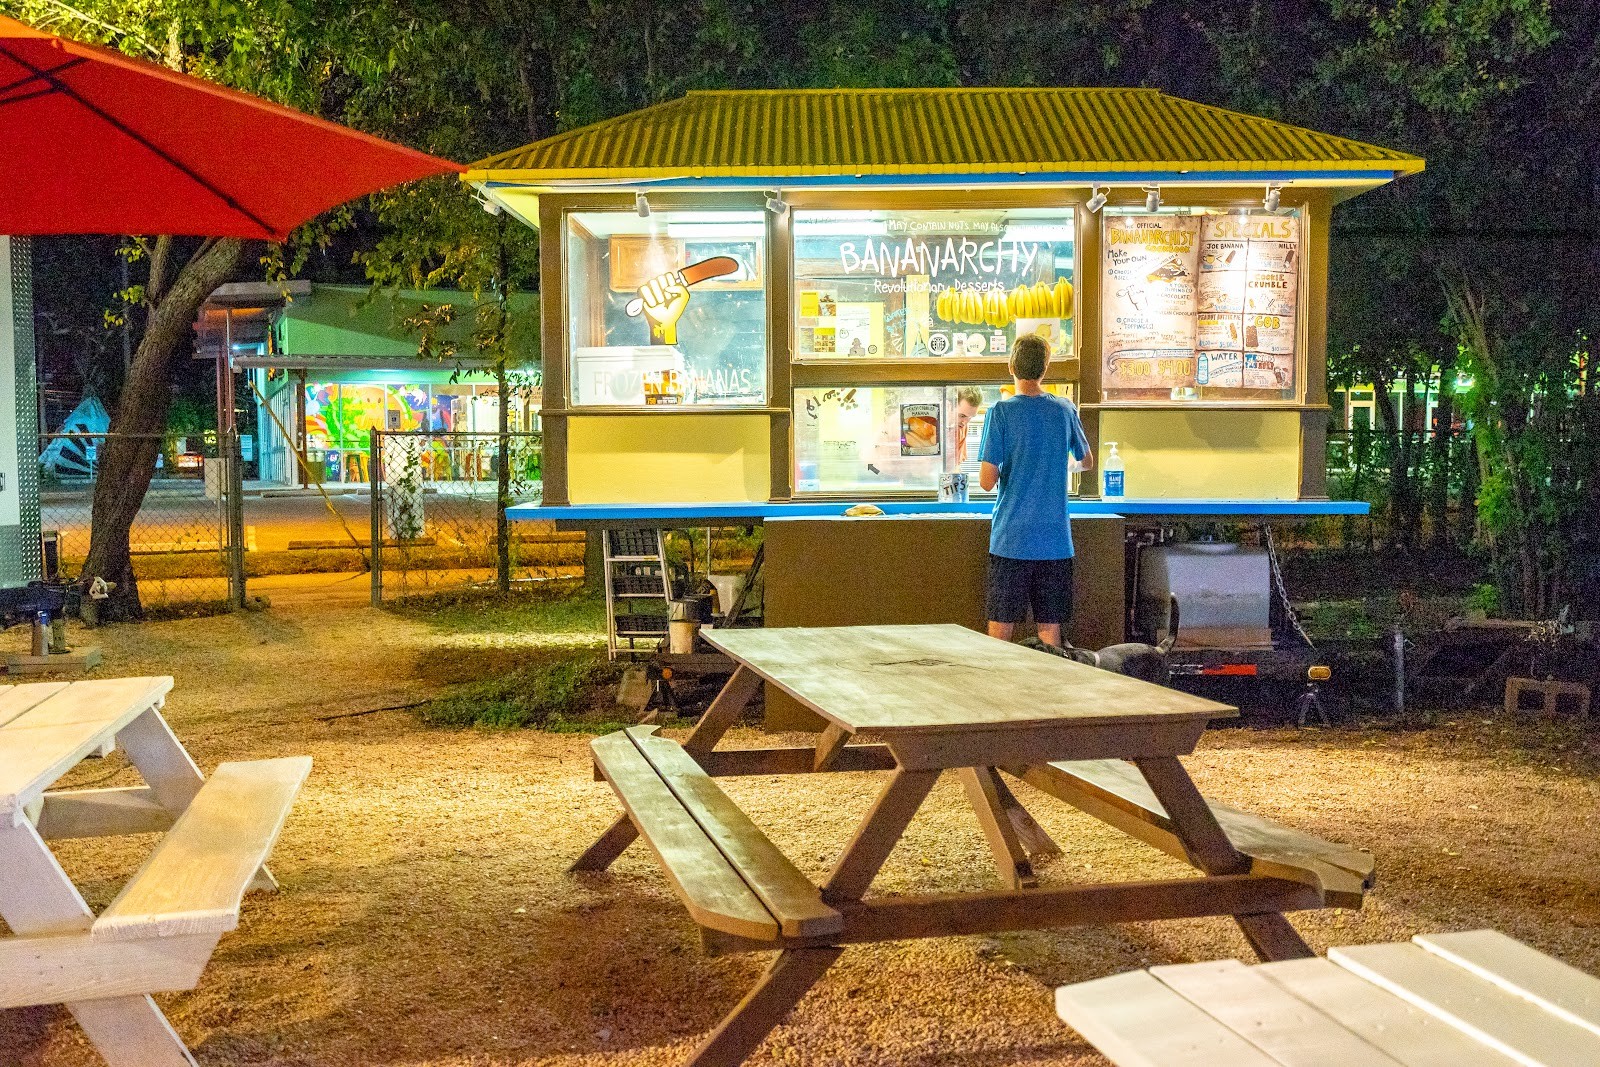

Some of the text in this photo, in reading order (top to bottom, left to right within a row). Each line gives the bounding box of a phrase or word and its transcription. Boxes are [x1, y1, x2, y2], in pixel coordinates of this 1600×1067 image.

[1110, 228, 1197, 247] BANANARCHIST
[1213, 220, 1292, 239] SPECIALS
[840, 237, 1038, 278] BANANARCHY
[1248, 281, 1288, 289] CRUMBLE
[1255, 273, 1285, 281] COOKIE
[954, 278, 1005, 293] Desserts
[1254, 315, 1281, 330] GOB
[1210, 352, 1238, 361] WATER
[592, 368, 751, 396] FROZEN BANANAS
[943, 479, 966, 496] TIPS
